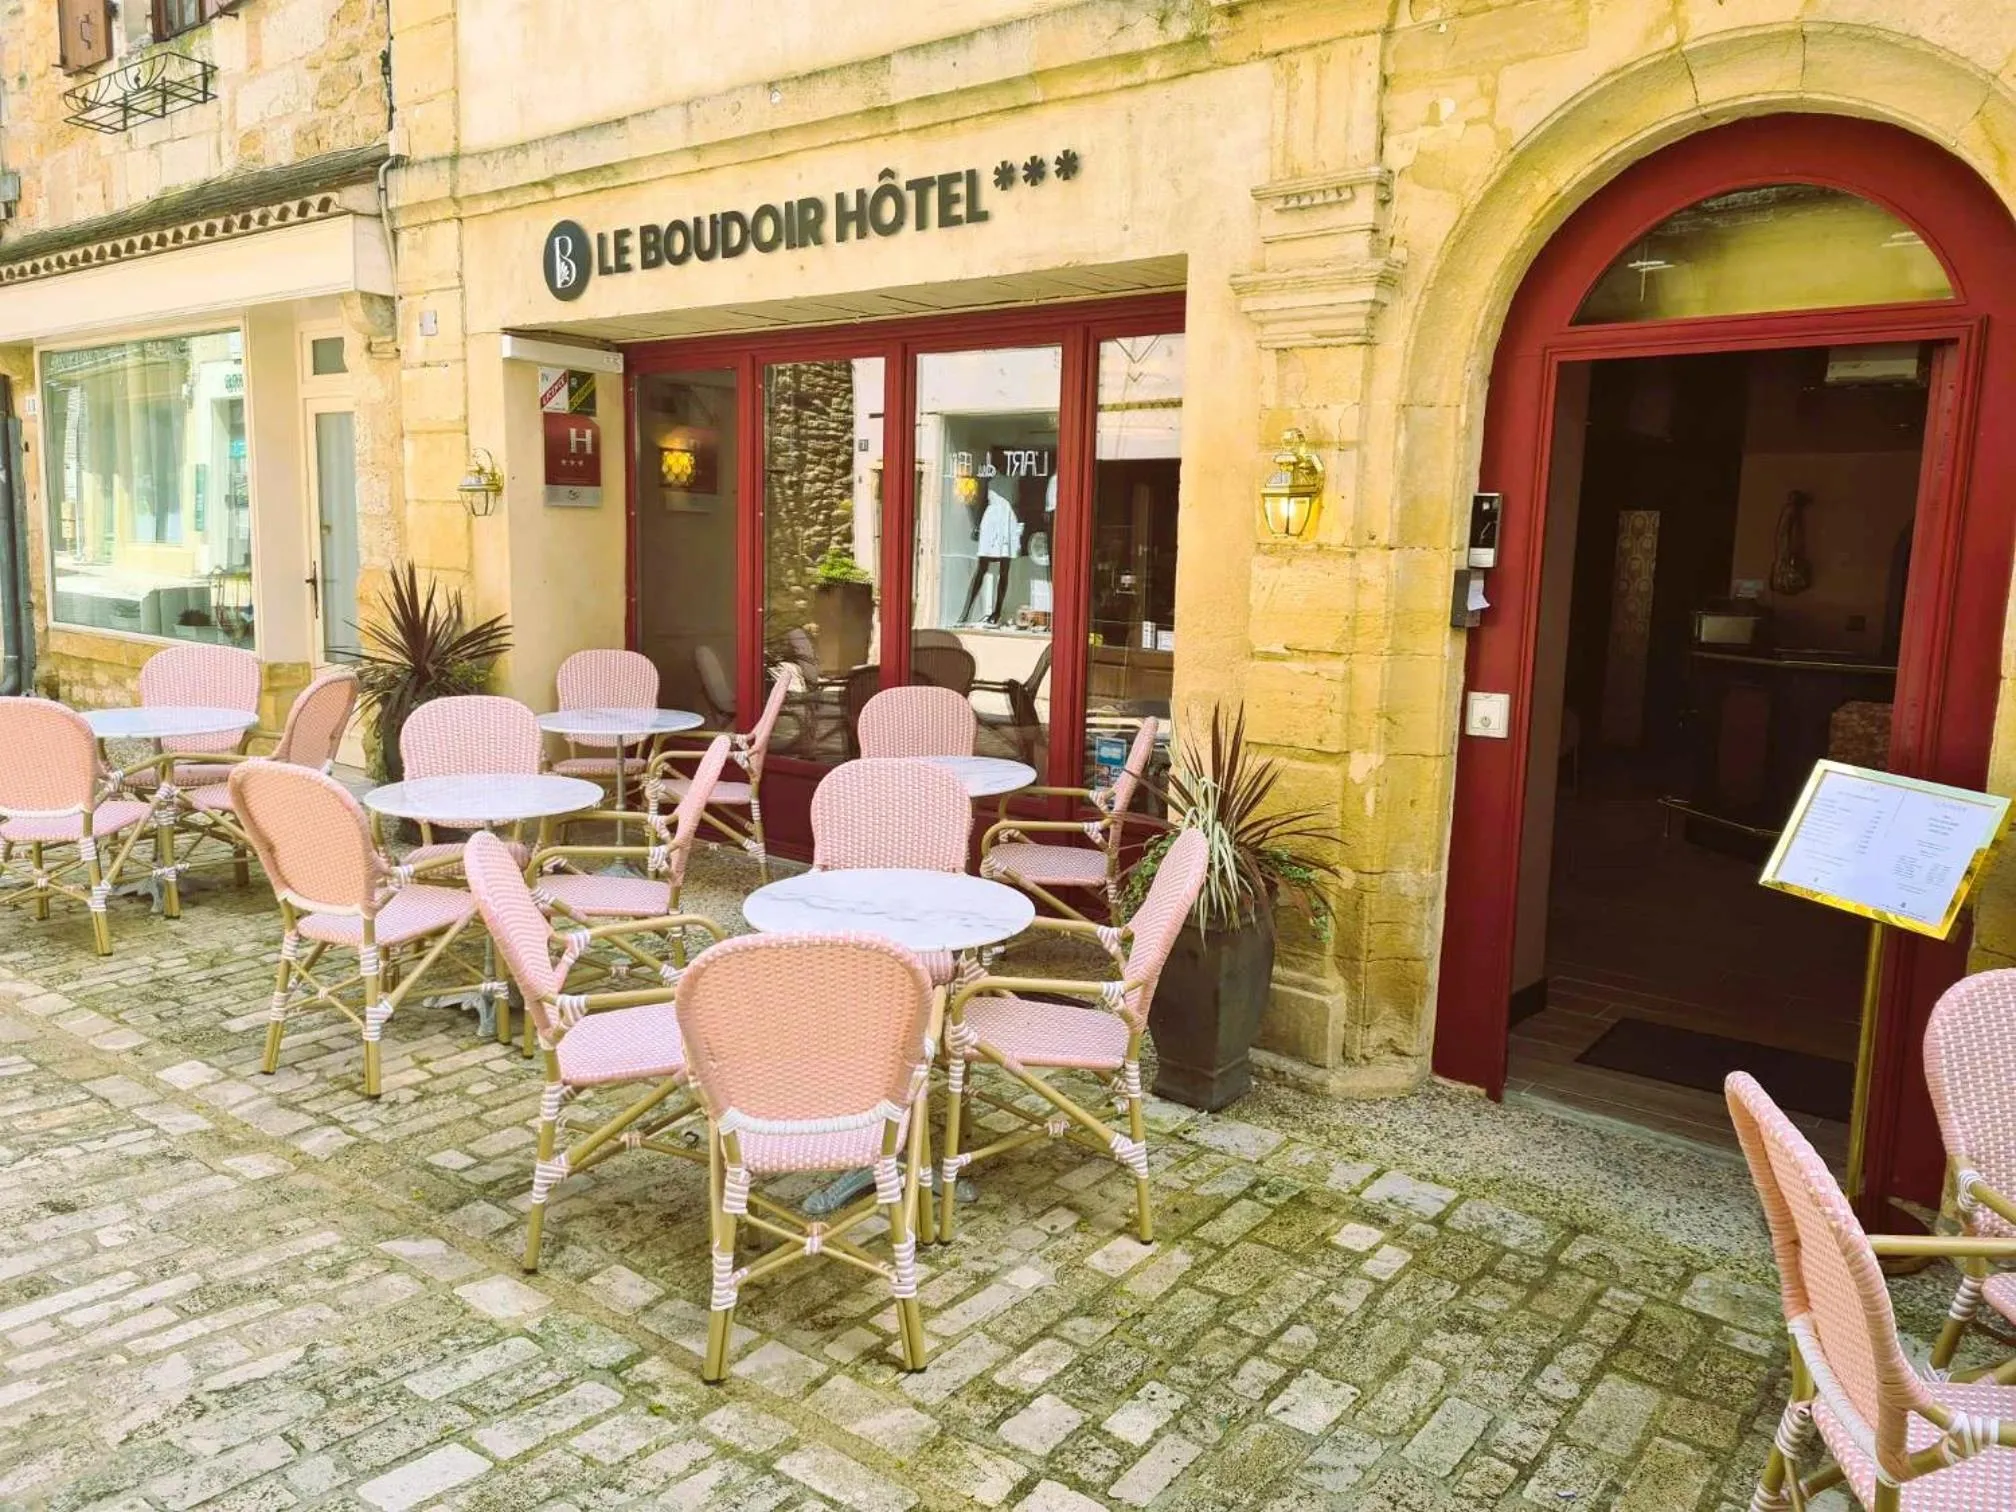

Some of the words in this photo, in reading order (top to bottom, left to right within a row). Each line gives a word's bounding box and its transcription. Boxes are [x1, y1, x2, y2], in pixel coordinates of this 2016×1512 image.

[597, 228, 633, 277] LE
[639, 196, 825, 271] BOUDOIR
[835, 167, 990, 243] HÔTEL
[569, 427, 593, 455] H
